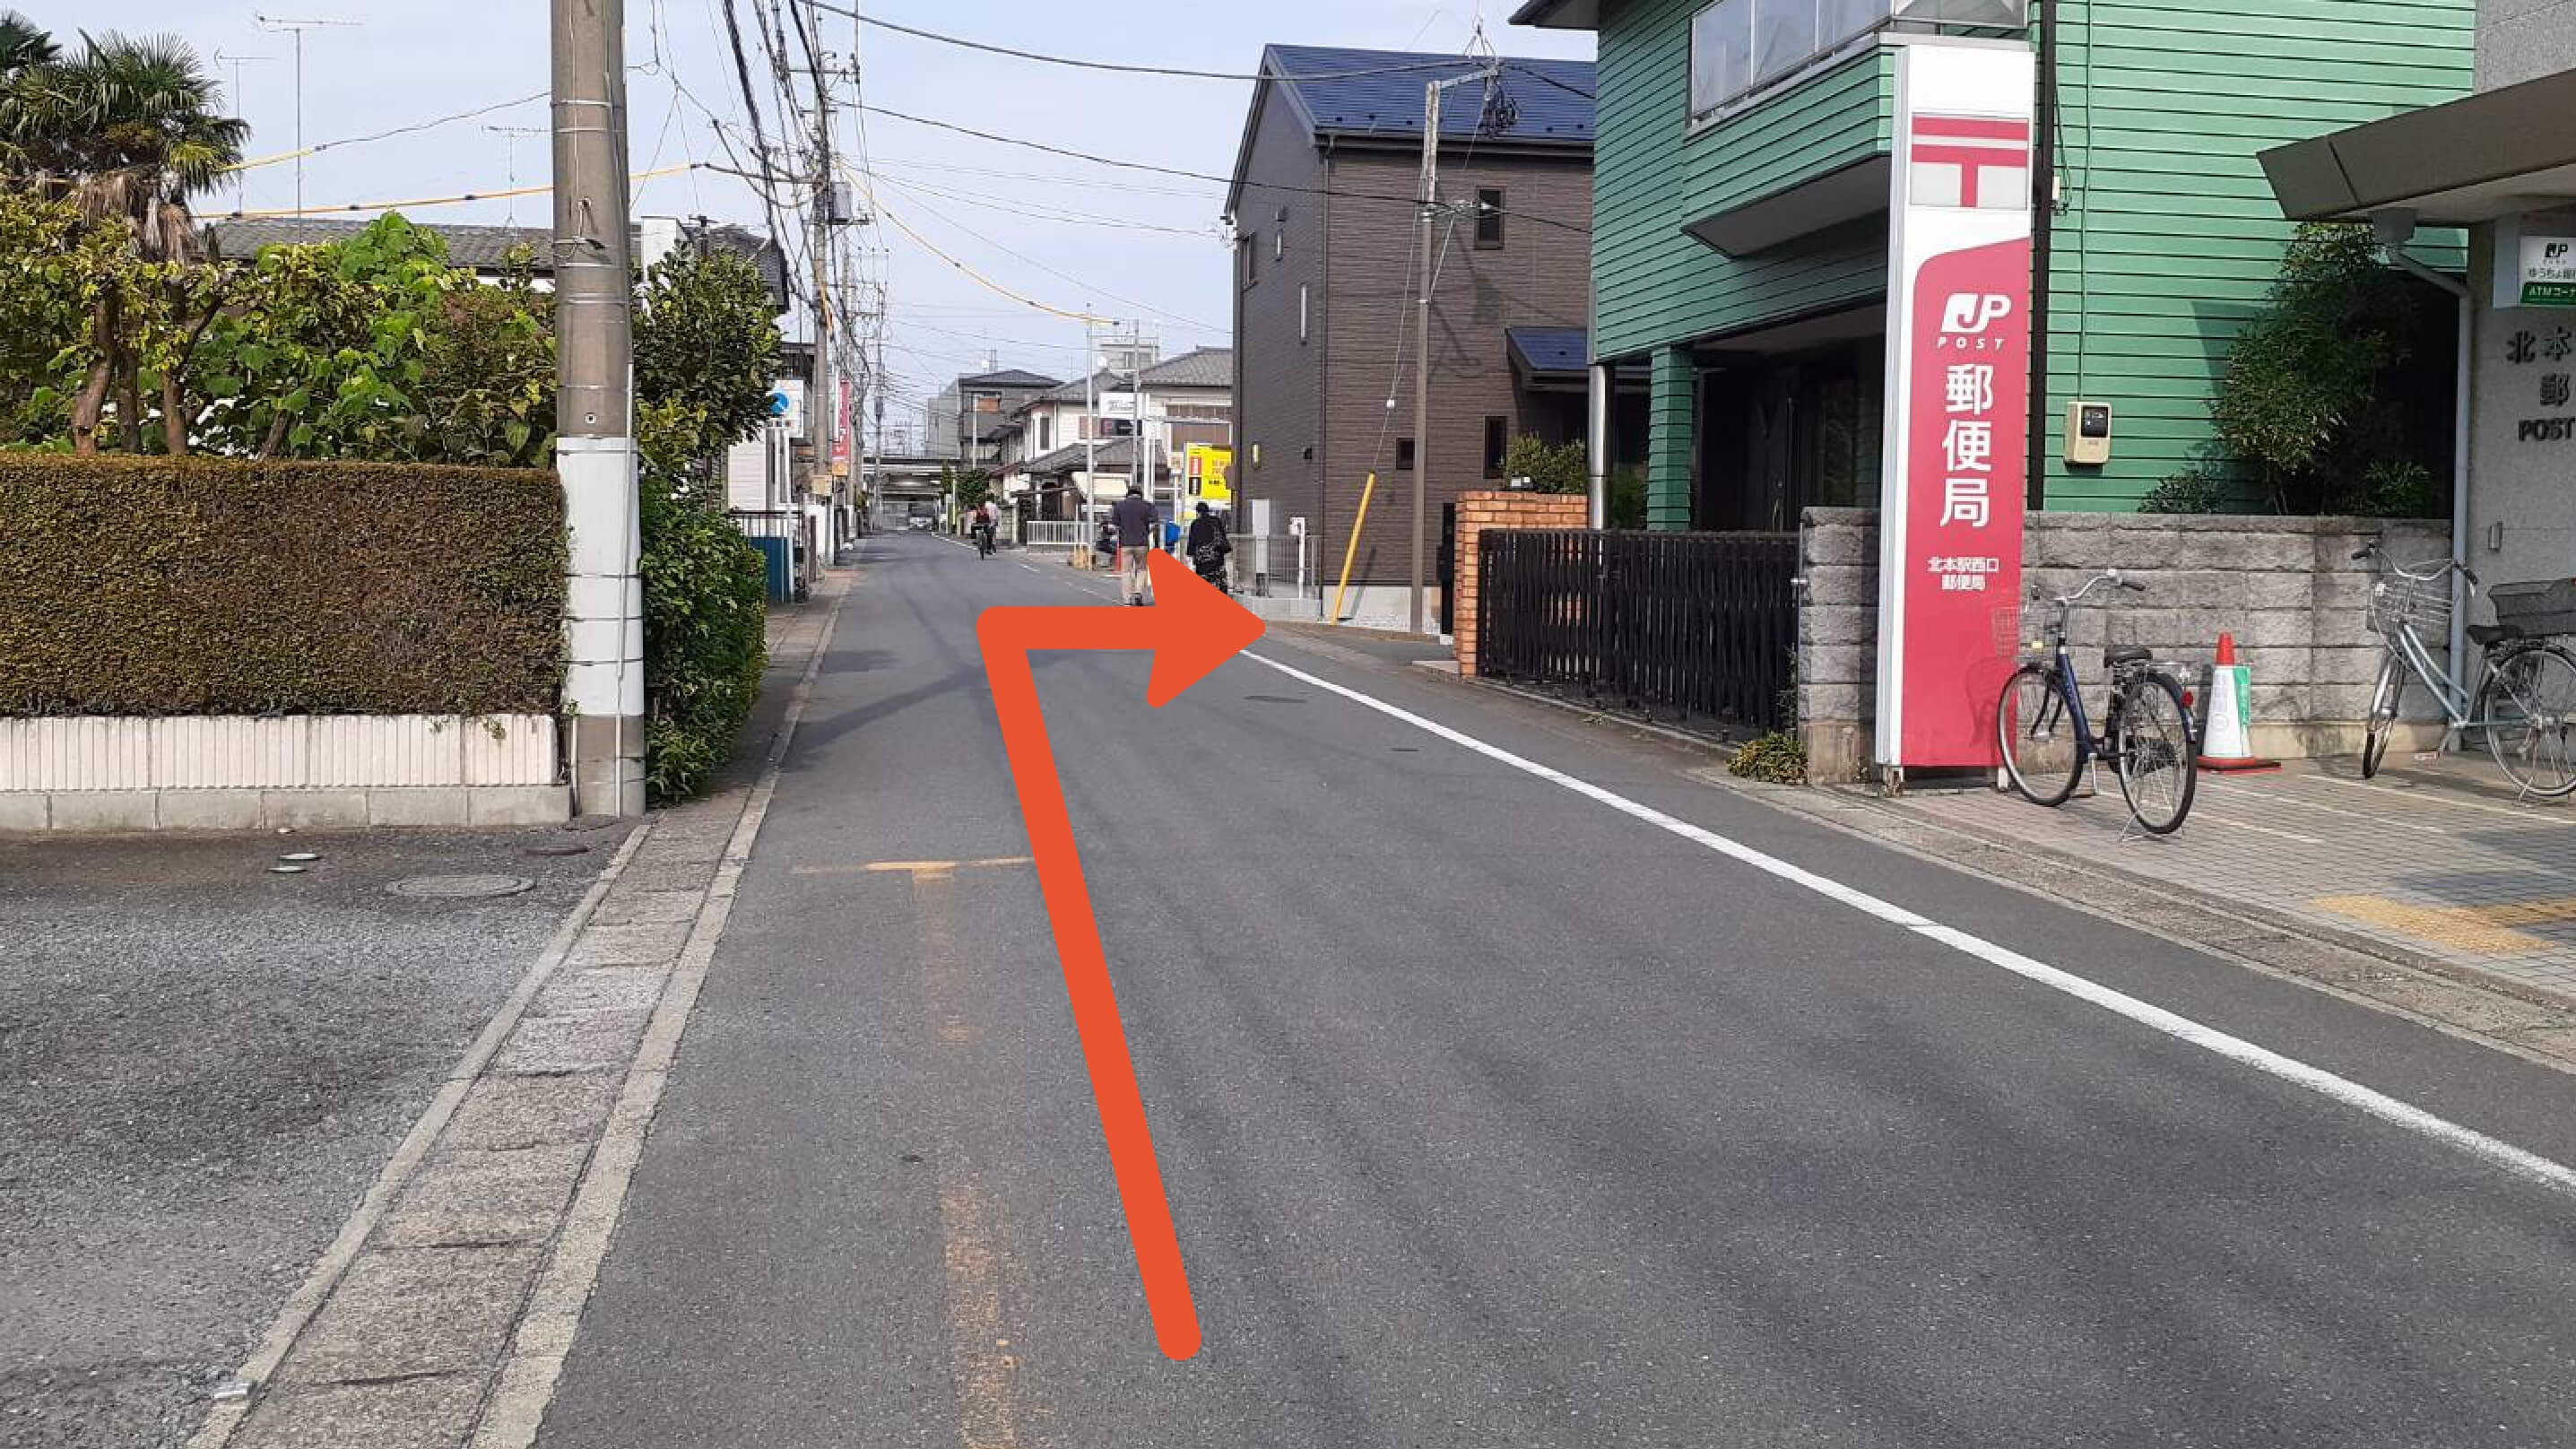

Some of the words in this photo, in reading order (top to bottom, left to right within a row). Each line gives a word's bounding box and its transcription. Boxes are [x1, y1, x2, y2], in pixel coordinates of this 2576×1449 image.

[2545, 242, 2569, 258] JP
[1940, 292, 2012, 333] JP
[1937, 336, 2005, 351] POST
[2518, 417, 2576, 442] POST
[1939, 363, 1994, 527] 郵便局
[1927, 555, 1999, 573] 北本駅西口
[1941, 574, 1986, 591] 郵便局
